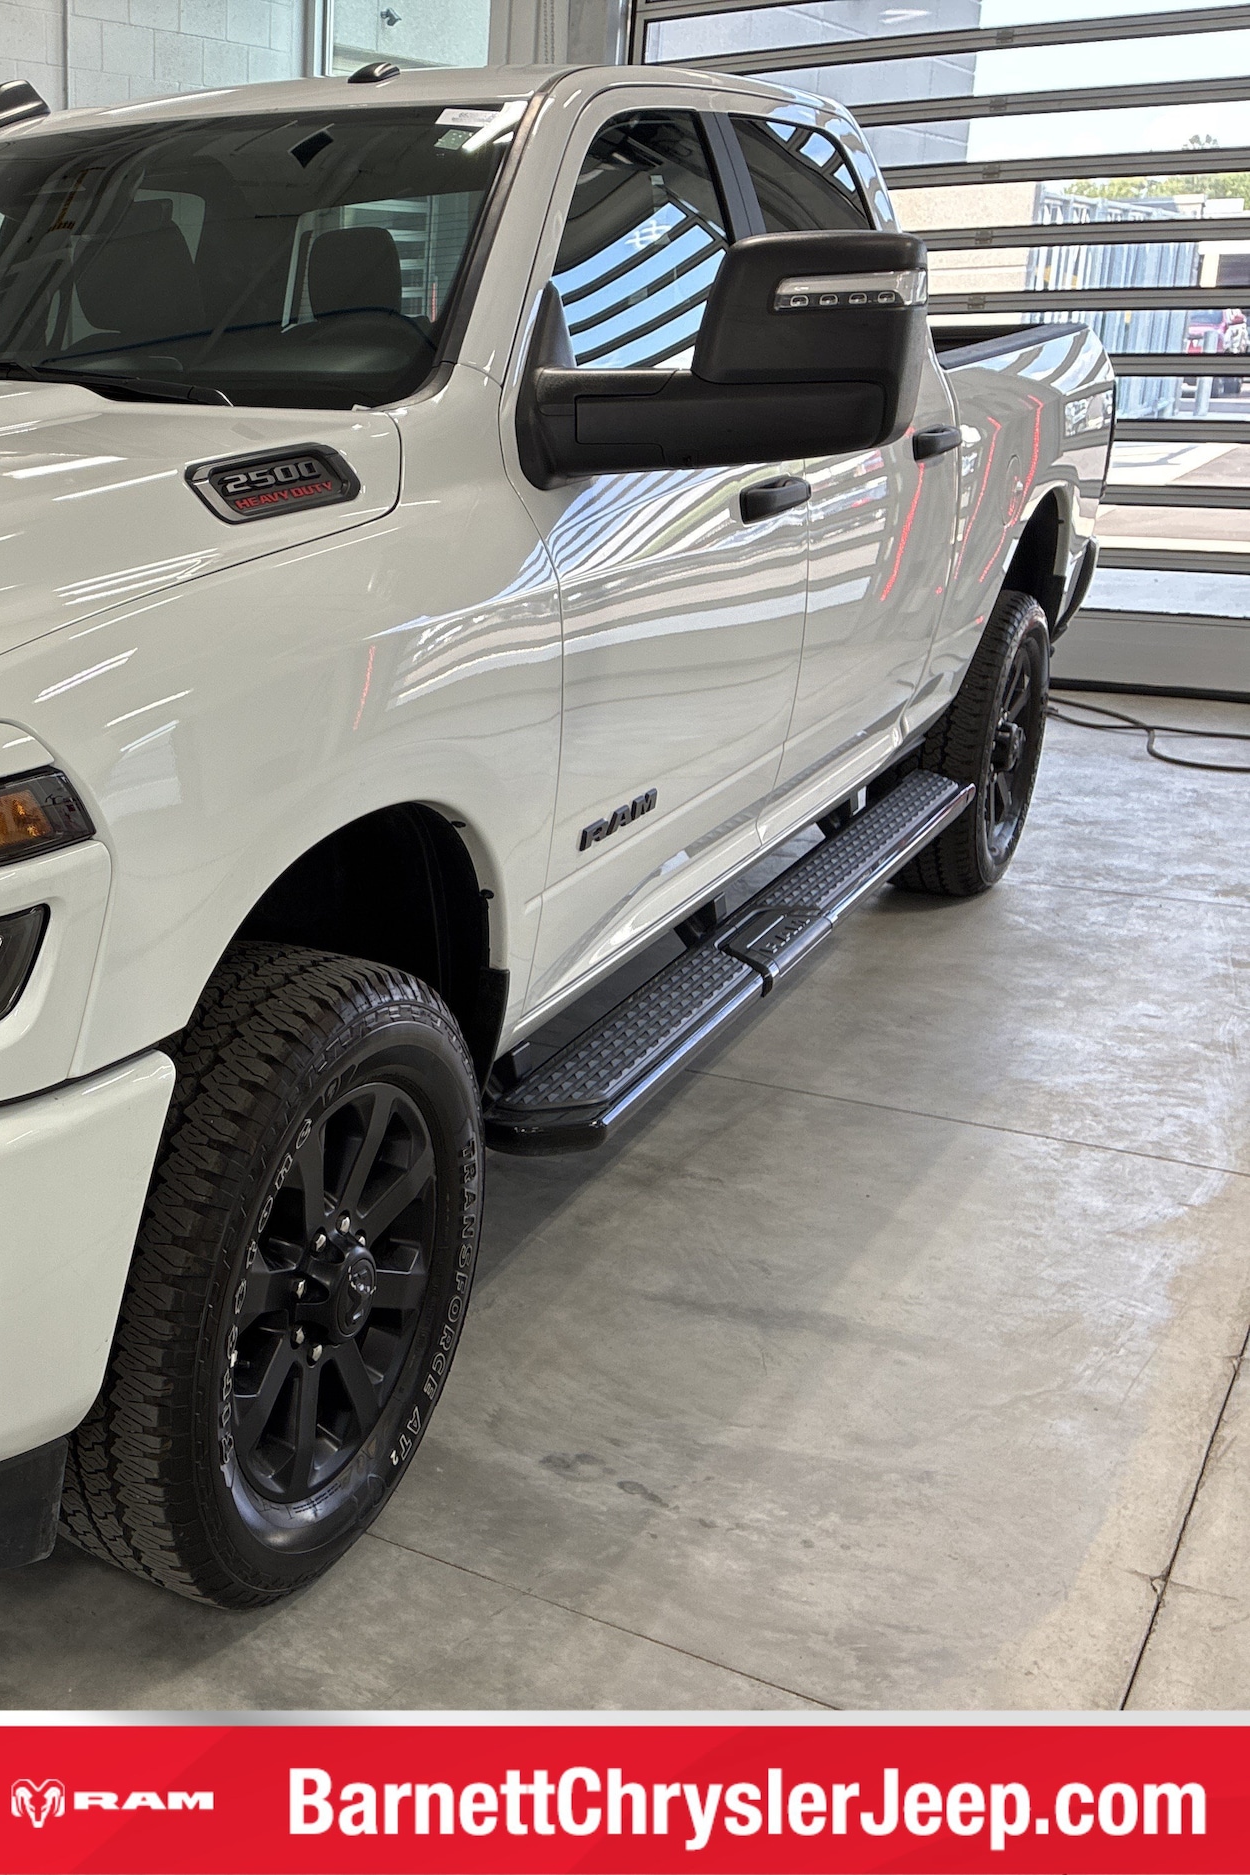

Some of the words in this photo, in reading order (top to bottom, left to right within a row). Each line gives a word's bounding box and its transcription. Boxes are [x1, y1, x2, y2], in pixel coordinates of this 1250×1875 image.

[222, 461, 320, 494] 2500
[236, 491, 290, 509] HEAVY
[290, 480, 333, 498] DUTY
[579, 787, 658, 852] RAM
[423, 1137, 477, 1400] TRANSFORCE
